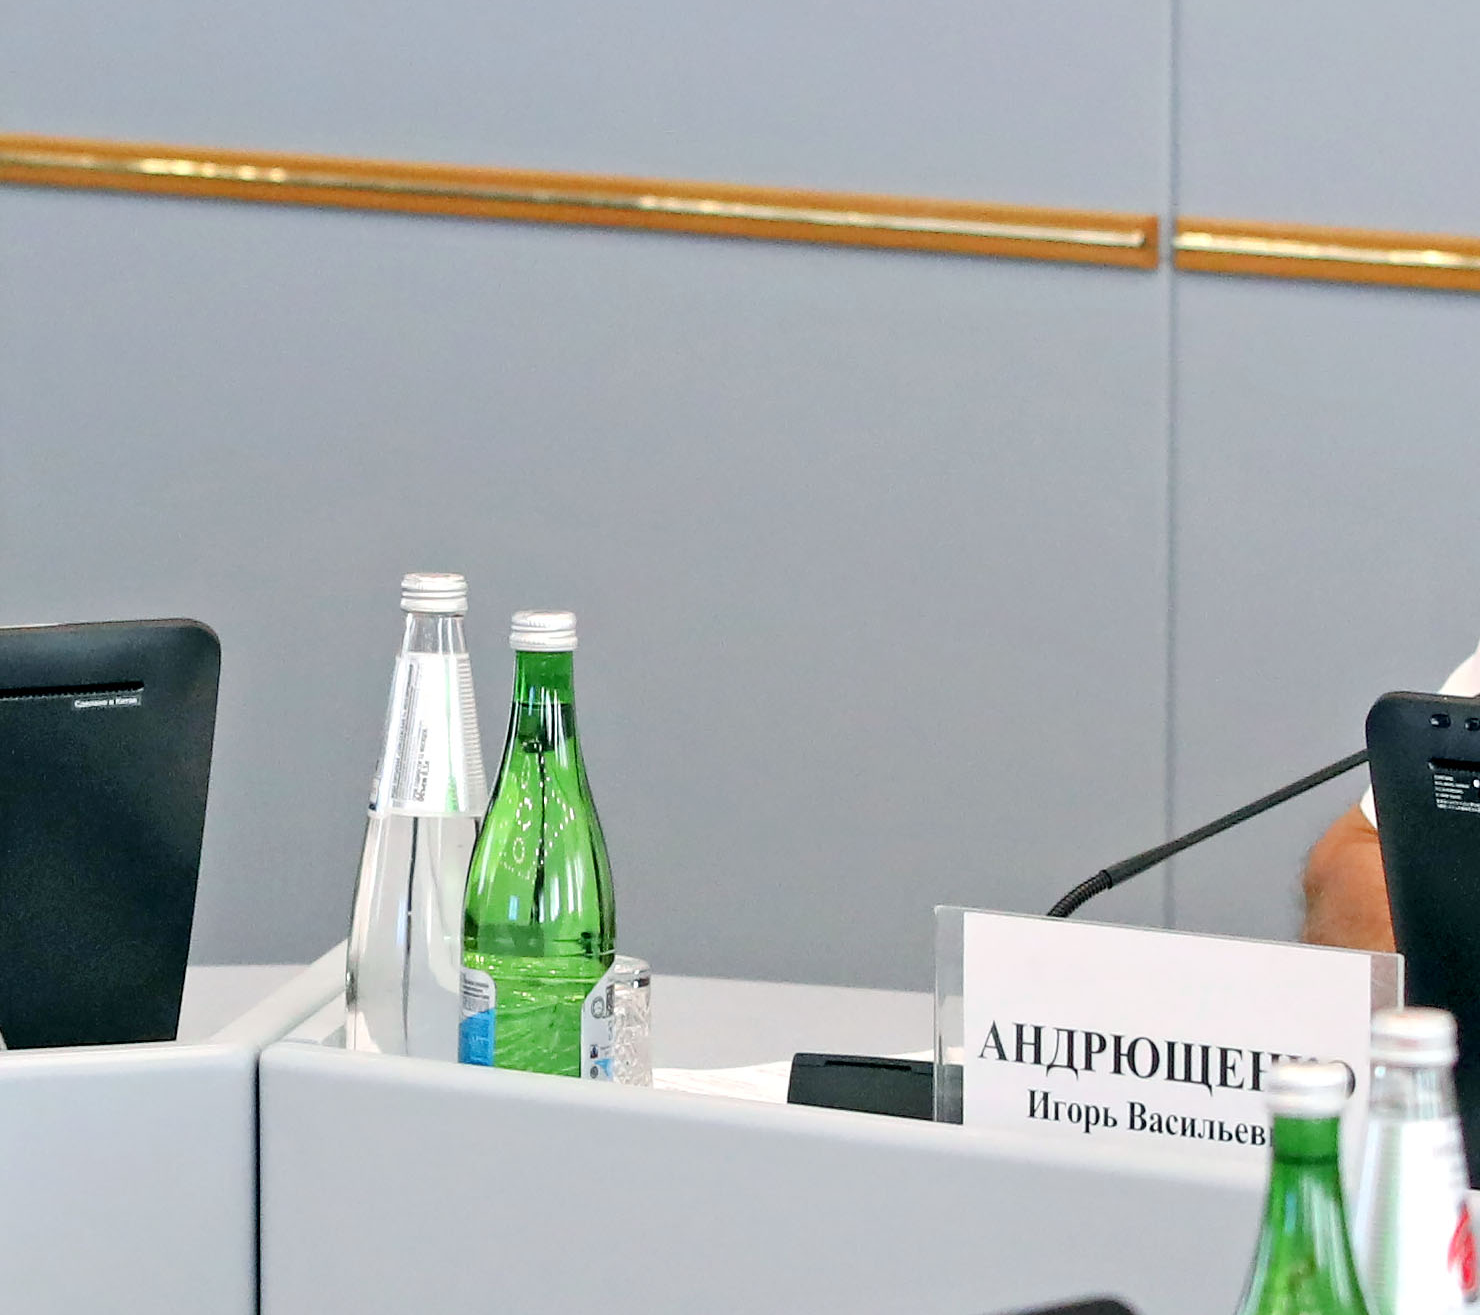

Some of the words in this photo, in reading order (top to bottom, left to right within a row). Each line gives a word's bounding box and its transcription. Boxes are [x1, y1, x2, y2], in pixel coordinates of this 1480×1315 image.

[978, 1020, 1356, 1101] АНДРЮЩЕН
[1026, 1088, 1118, 1133] Игорь
[1127, 1100, 1273, 1148] Васильев
